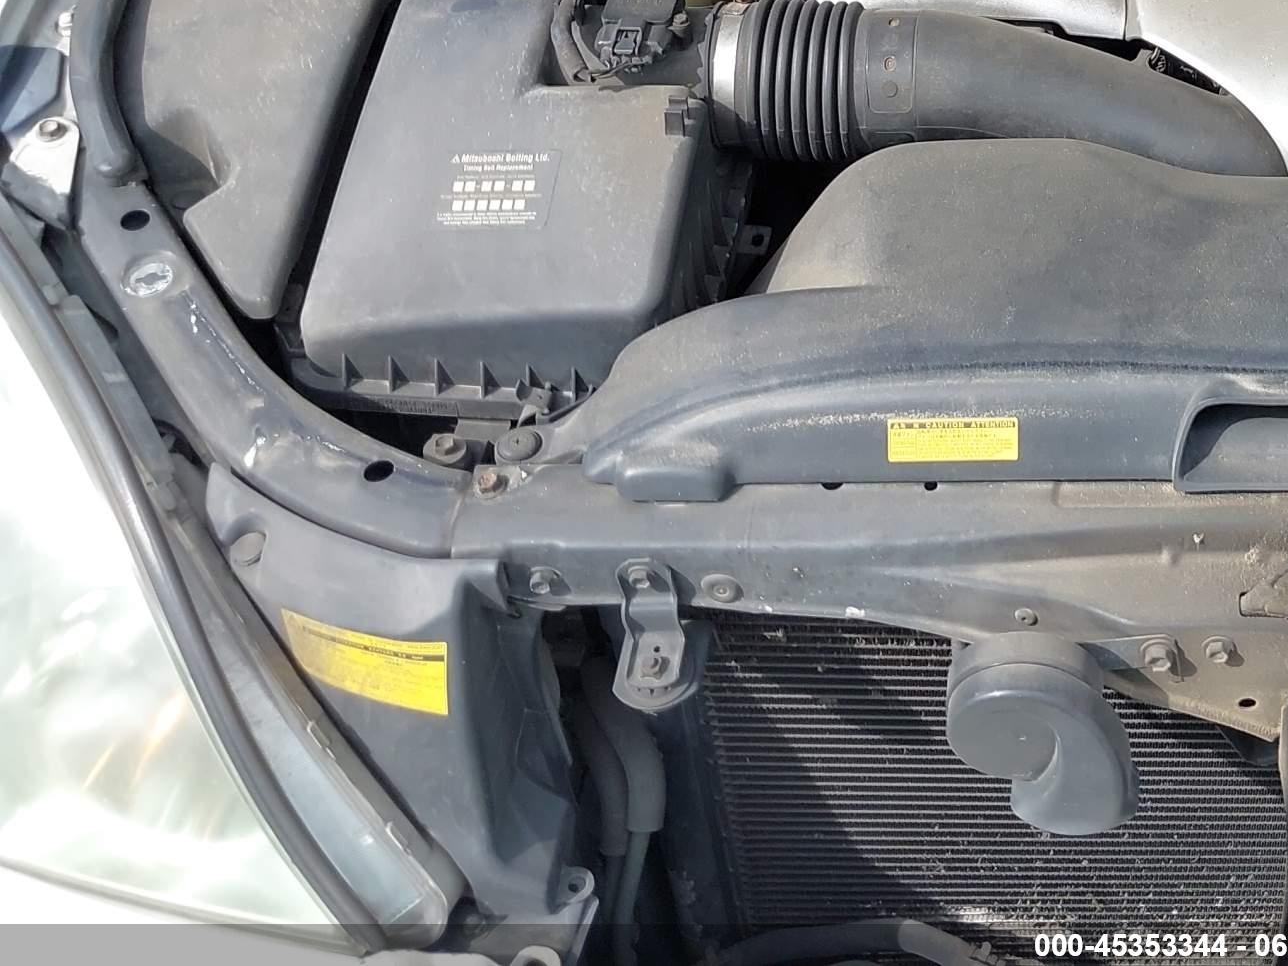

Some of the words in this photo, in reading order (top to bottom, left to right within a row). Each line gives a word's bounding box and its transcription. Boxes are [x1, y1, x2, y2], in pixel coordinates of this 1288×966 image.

[535, 153, 550, 162] Ltd.
[925, 421, 964, 429] CAUTION
[970, 420, 1014, 428] ATTENTION
